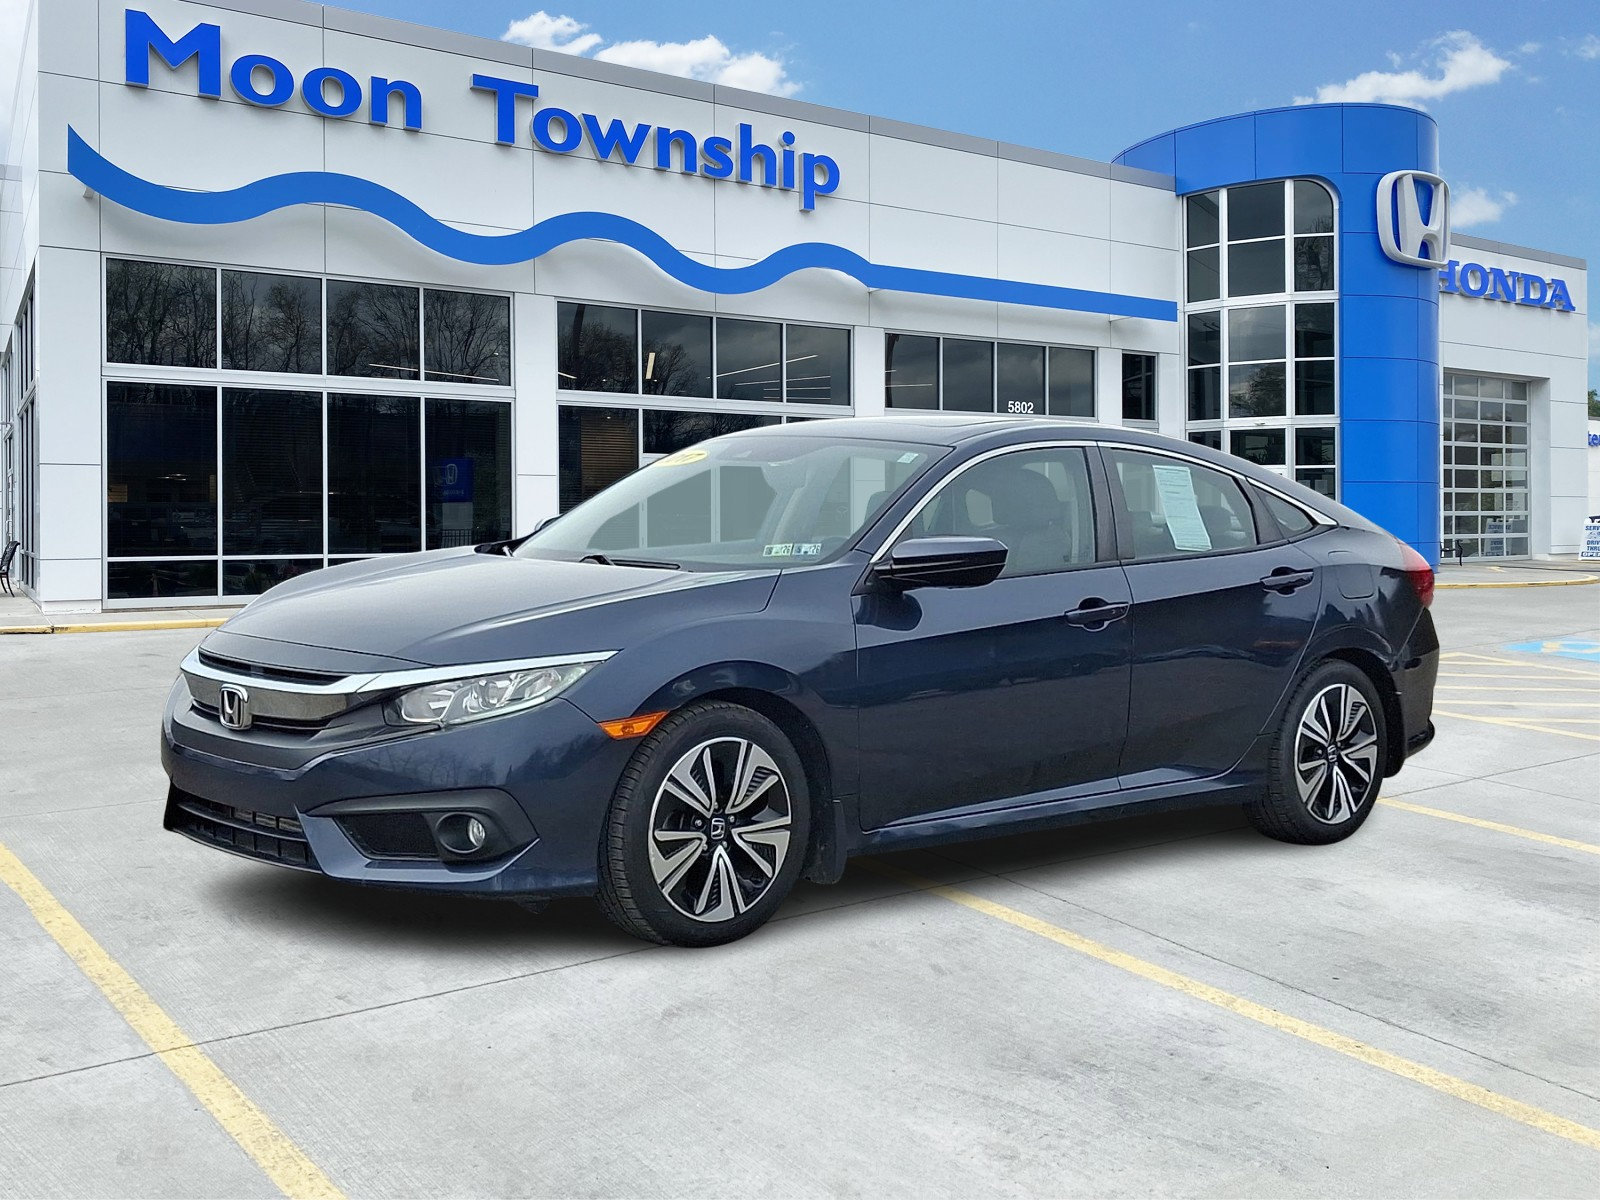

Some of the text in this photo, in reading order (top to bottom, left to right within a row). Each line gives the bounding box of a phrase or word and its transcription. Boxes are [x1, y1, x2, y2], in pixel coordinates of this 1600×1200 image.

[125, 9, 841, 212] Moon Township
[1438, 259, 1576, 312] HONDA
[1007, 400, 1034, 414] 5802
